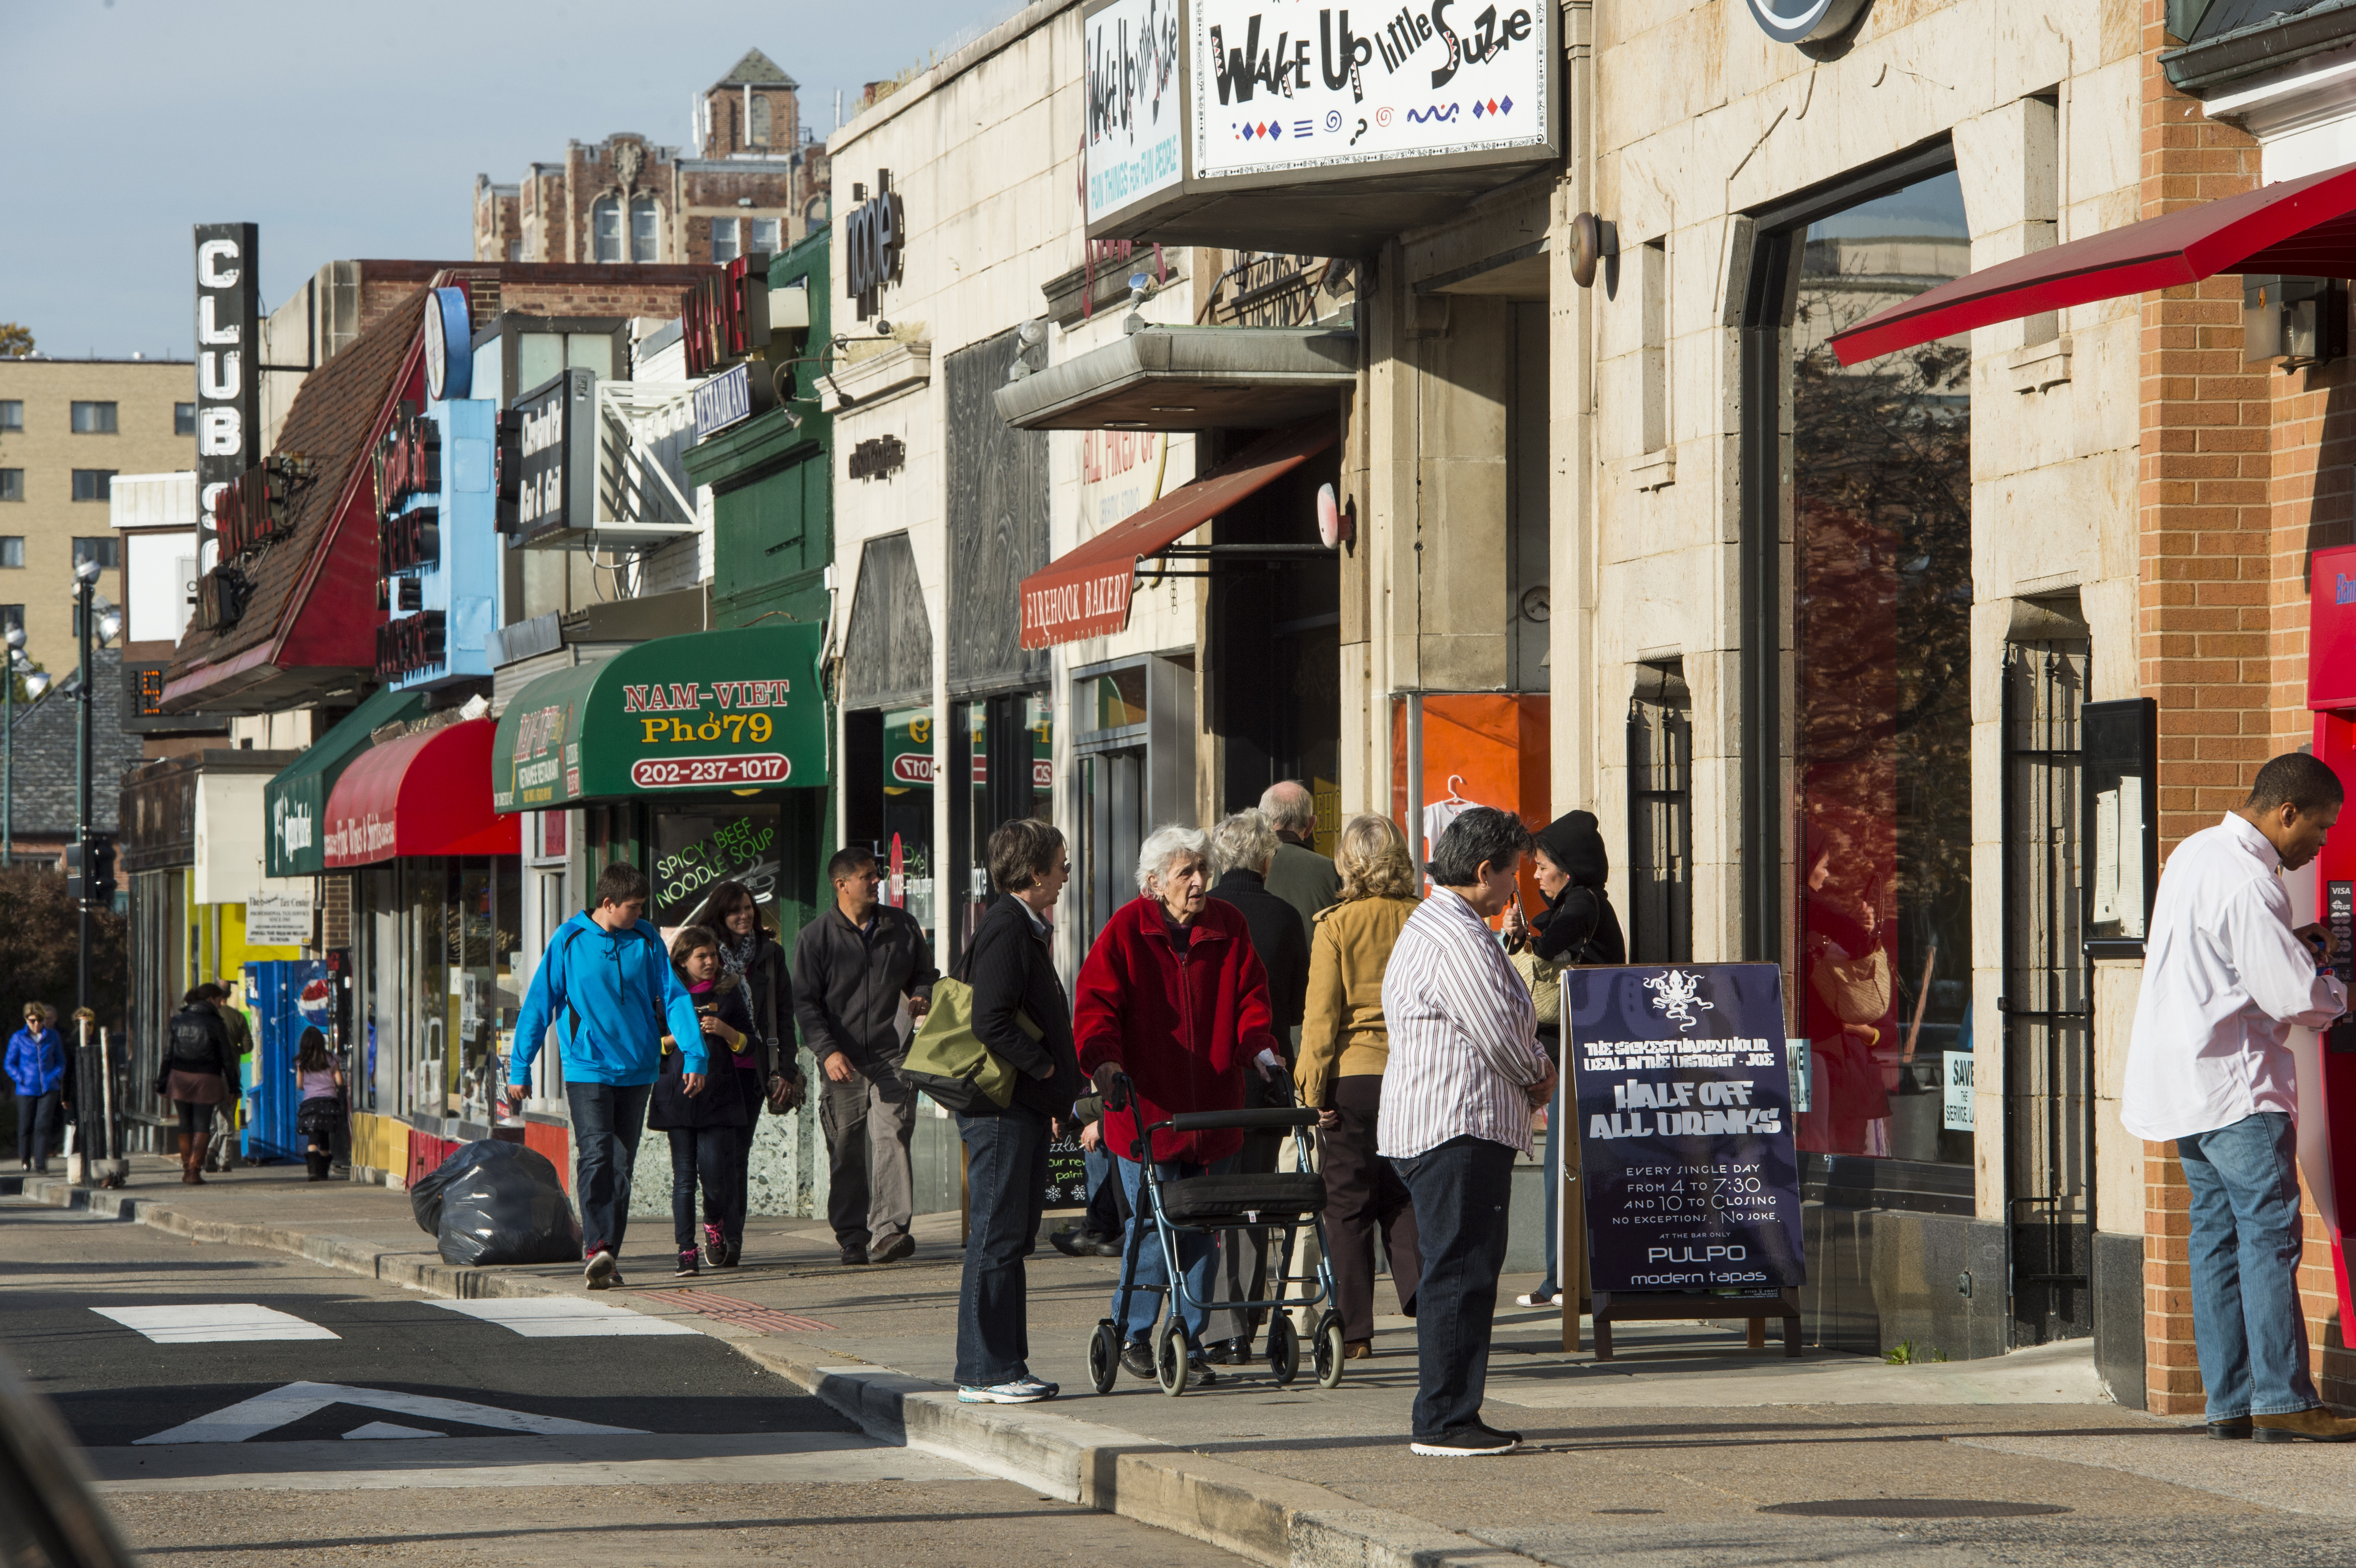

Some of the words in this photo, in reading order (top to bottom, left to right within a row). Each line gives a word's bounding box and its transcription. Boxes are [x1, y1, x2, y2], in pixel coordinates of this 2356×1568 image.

[1320, 9, 1372, 105] Up
[1374, 6, 1432, 75] little
[1431, 0, 1531, 89] Suzie
[1118, 17, 1135, 148] Up
[1136, 14, 1152, 107] little
[1151, 0, 1177, 126] Suzie
[1091, 172, 1103, 211] FUN
[1105, 161, 1128, 204] THINGS
[1130, 162, 1139, 194] FOR
[1141, 146, 1154, 188] FUN
[1156, 134, 1177, 181] PEOPLE
[197, 239, 241, 456] CLUB
[695, 367, 750, 433] RESTAURANT
[1083, 430, 1102, 485] ALL
[520, 480, 535, 523] Bar
[1122, 486, 1140, 518] STUDIO
[1027, 583, 1080, 636] FIREHOOK
[1085, 573, 1129, 618] BAKERY
[623, 680, 789, 712] NAM-VIET
[639, 759, 783, 783] 202-237-1017
[657, 840, 706, 879] SPICY
[713, 817, 751, 849] BEEF
[656, 854, 728, 909] NOODLE
[730, 828, 774, 864] SOUP
[1584, 1041, 1614, 1056] THE
[1677, 1037, 1726, 1053] HAPPY
[1726, 1036, 1770, 1052] HOUR
[1789, 1046, 1803, 1070] AVE
[1584, 1056, 1625, 1071] DEAL
[1644, 1053, 1671, 1069] THE
[1745, 1053, 1775, 1067] JOE
[1953, 1059, 1974, 1087] SAVE
[1614, 1079, 1695, 1112] HALF
[1699, 1081, 1754, 1106] OFF
[1590, 1112, 1654, 1139] ALL
[1946, 1105, 1967, 1123] SERVICE
[1056, 1170, 1083, 1183] paint
[1626, 1166, 1671, 1176] EVERY
[1677, 1165, 1727, 1175] SINGLE
[1733, 1164, 1760, 1173] DAY
[1627, 1183, 1665, 1193] FROM
[1671, 1179, 1685, 1194] 4
[1690, 1182, 1707, 1190] TO
[1713, 1177, 1761, 1193] 7:30
[1624, 1199, 1654, 1209] AND
[1659, 1196, 1682, 1211] 10
[1688, 1198, 1705, 1207] TO
[1711, 1194, 1777, 1209] CLOSING
[1748, 1212, 1780, 1222] JOKE.
[1648, 1245, 1746, 1263] PULPO
[1631, 1273, 1704, 1285] modern
[1709, 1271, 1767, 1284] tapas
